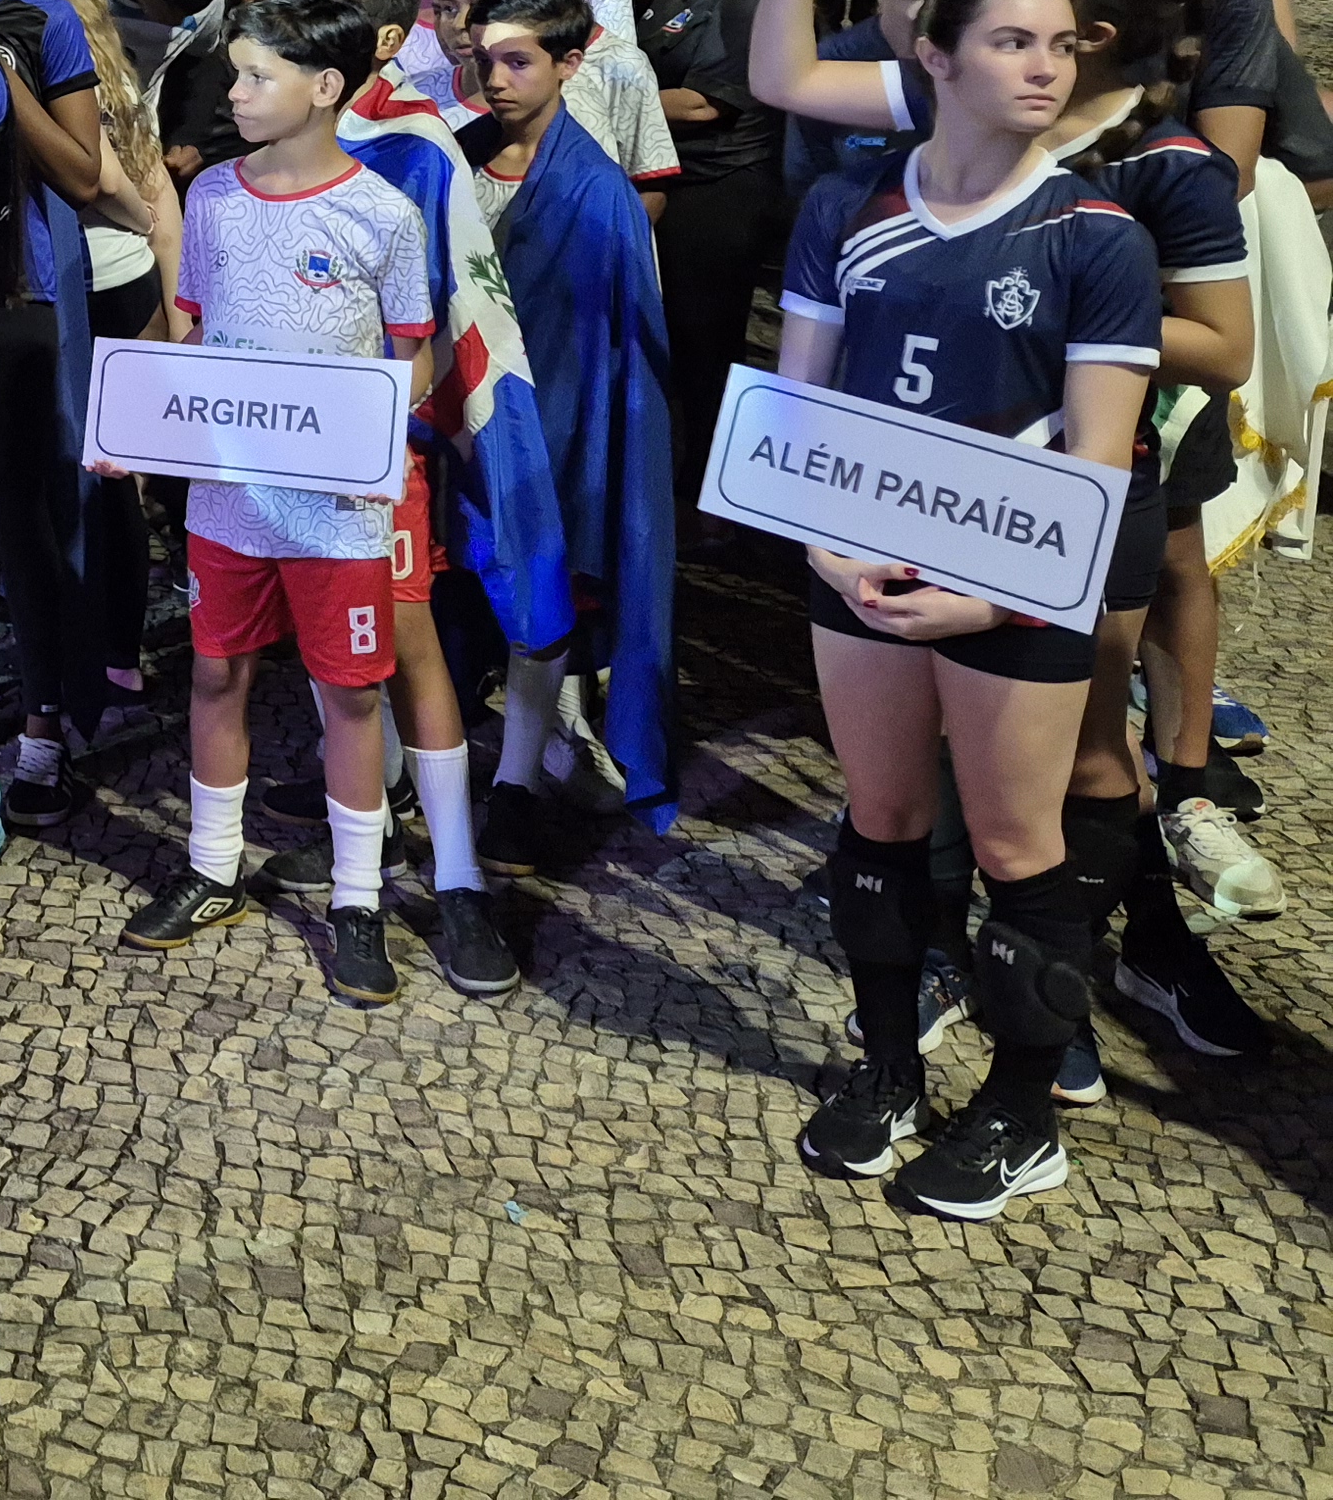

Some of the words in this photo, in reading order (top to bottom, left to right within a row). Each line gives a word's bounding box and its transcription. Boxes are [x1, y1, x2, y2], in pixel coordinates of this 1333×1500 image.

[892, 334, 939, 405] 5
[162, 394, 321, 434] ARGIRITA
[748, 434, 865, 495] ALÉM
[874, 469, 1068, 559] PARAÍBA
[348, 605, 377, 655] 8
